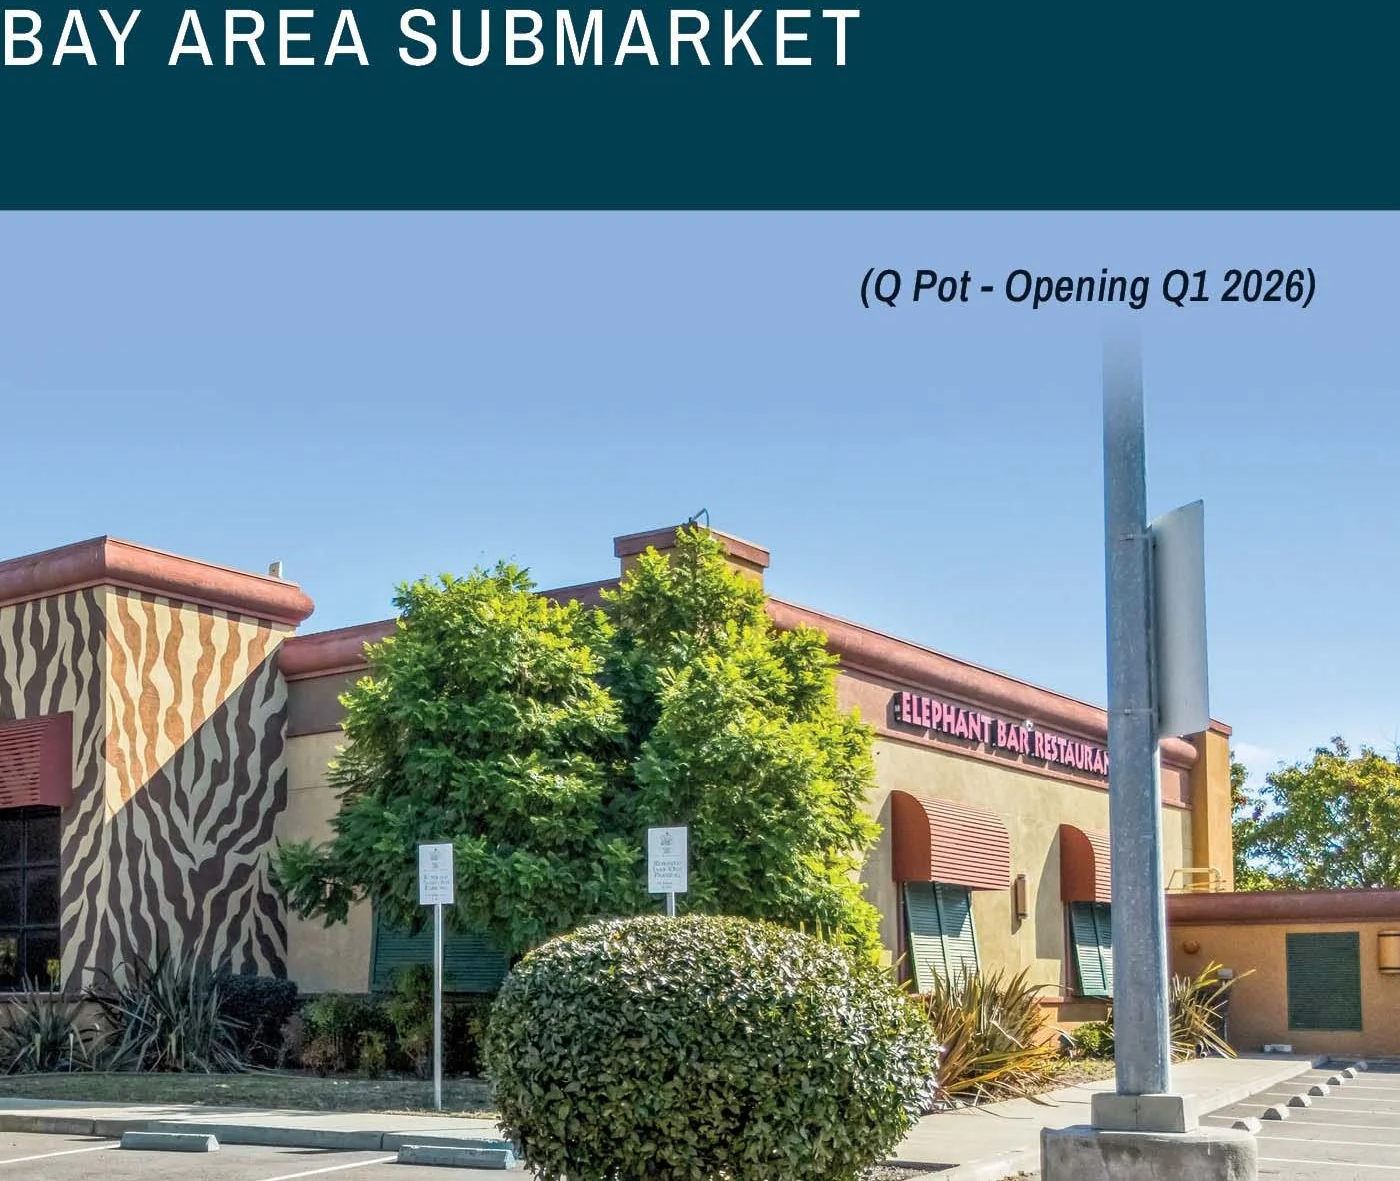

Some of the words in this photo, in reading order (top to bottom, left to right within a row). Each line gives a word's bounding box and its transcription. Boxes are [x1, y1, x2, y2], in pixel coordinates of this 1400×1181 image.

[901, 691, 992, 744] ELEPHANT
[997, 719, 1030, 754] BAR
[1034, 731, 1109, 776] RESTAURAN
